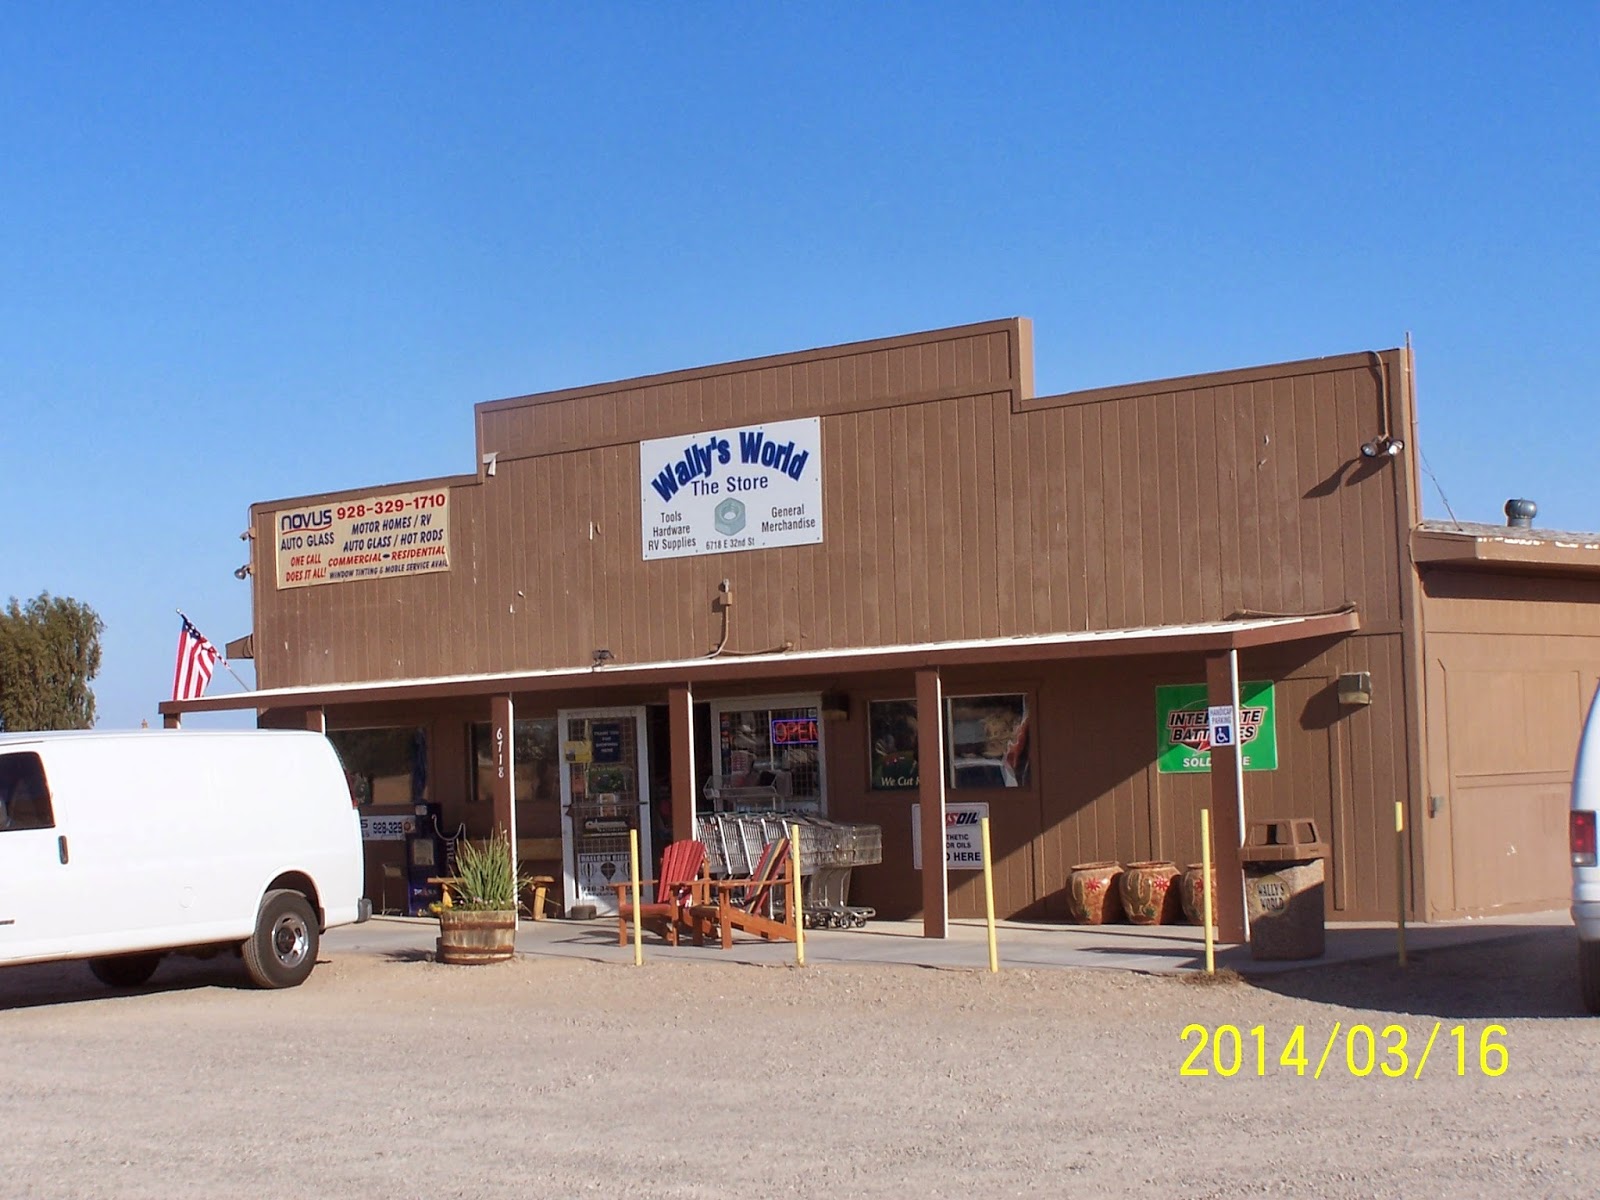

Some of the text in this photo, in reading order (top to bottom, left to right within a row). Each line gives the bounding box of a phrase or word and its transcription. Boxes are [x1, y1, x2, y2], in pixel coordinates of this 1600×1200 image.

[651, 431, 809, 503] Wally's World
[692, 476, 769, 496] The Store
[336, 493, 446, 520] 928-329-1710
[771, 503, 805, 518] General
[281, 509, 332, 531] NOVUS
[351, 519, 380, 535] MOTOR
[382, 516, 412, 531] HOMES
[420, 513, 432, 527] RV
[660, 511, 682, 523] Tools
[761, 517, 816, 533] Merchandise
[653, 524, 691, 537] Hardware
[280, 532, 335, 551] AUTO GLASS
[343, 537, 365, 553] AUTO
[367, 535, 392, 550] GLASS
[400, 532, 418, 546] HOT
[420, 529, 444, 544] RODS
[648, 536, 697, 551] RV Supplies
[705, 537, 755, 550] 6718 E 32nd St
[290, 553, 322, 567] ONE CALL
[328, 545, 446, 567] COMMERCIAL RESIDENTIAL
[285, 567, 327, 582] DOES IT ALL!
[329, 570, 354, 580] WINDOW
[355, 567, 378, 576] TINTING
[406, 561, 430, 572] SERVICE
[1170, 710, 1262, 726] INTETE
[775, 720, 819, 742] OPEN
[1173, 726, 1254, 741] BATTES
[496, 727, 505, 779] 6718
[881, 776, 896, 787] We
[946, 812, 979, 827] SOIL
[946, 833, 969, 841] THETIC
[953, 851, 982, 862] HERE
